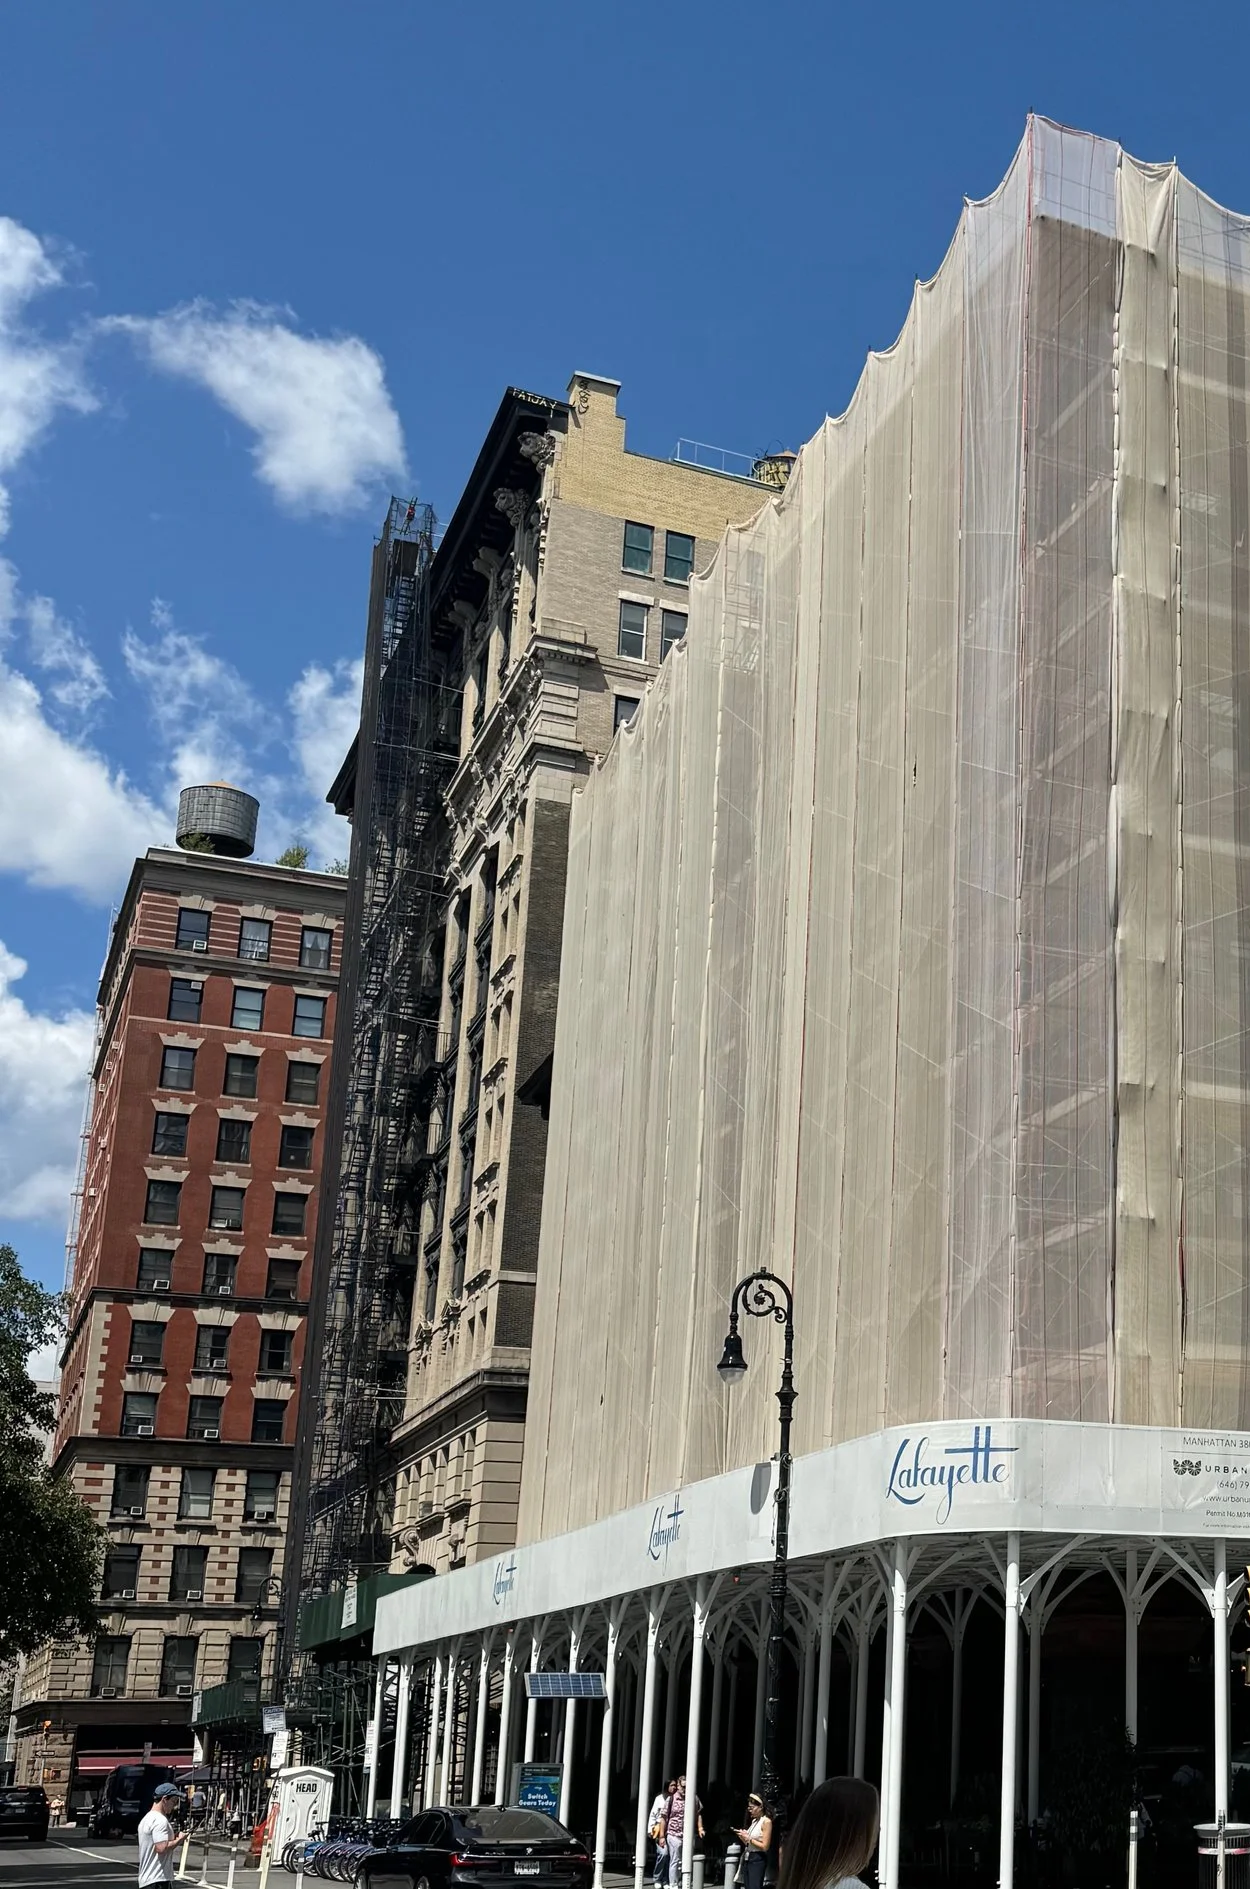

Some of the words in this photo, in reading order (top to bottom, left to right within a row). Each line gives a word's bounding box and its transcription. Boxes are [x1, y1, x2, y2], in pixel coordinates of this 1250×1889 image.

[1183, 1437, 1237, 1448] MANHATTAN
[885, 1426, 1019, 1525] Lafayette
[1205, 1465, 1248, 1474] URBAN
[1217, 1478, 1238, 1490] (646)
[647, 1494, 684, 1576] Lafayette
[493, 1554, 517, 1608] Lafayette
[296, 1783, 317, 1792] HEAD
